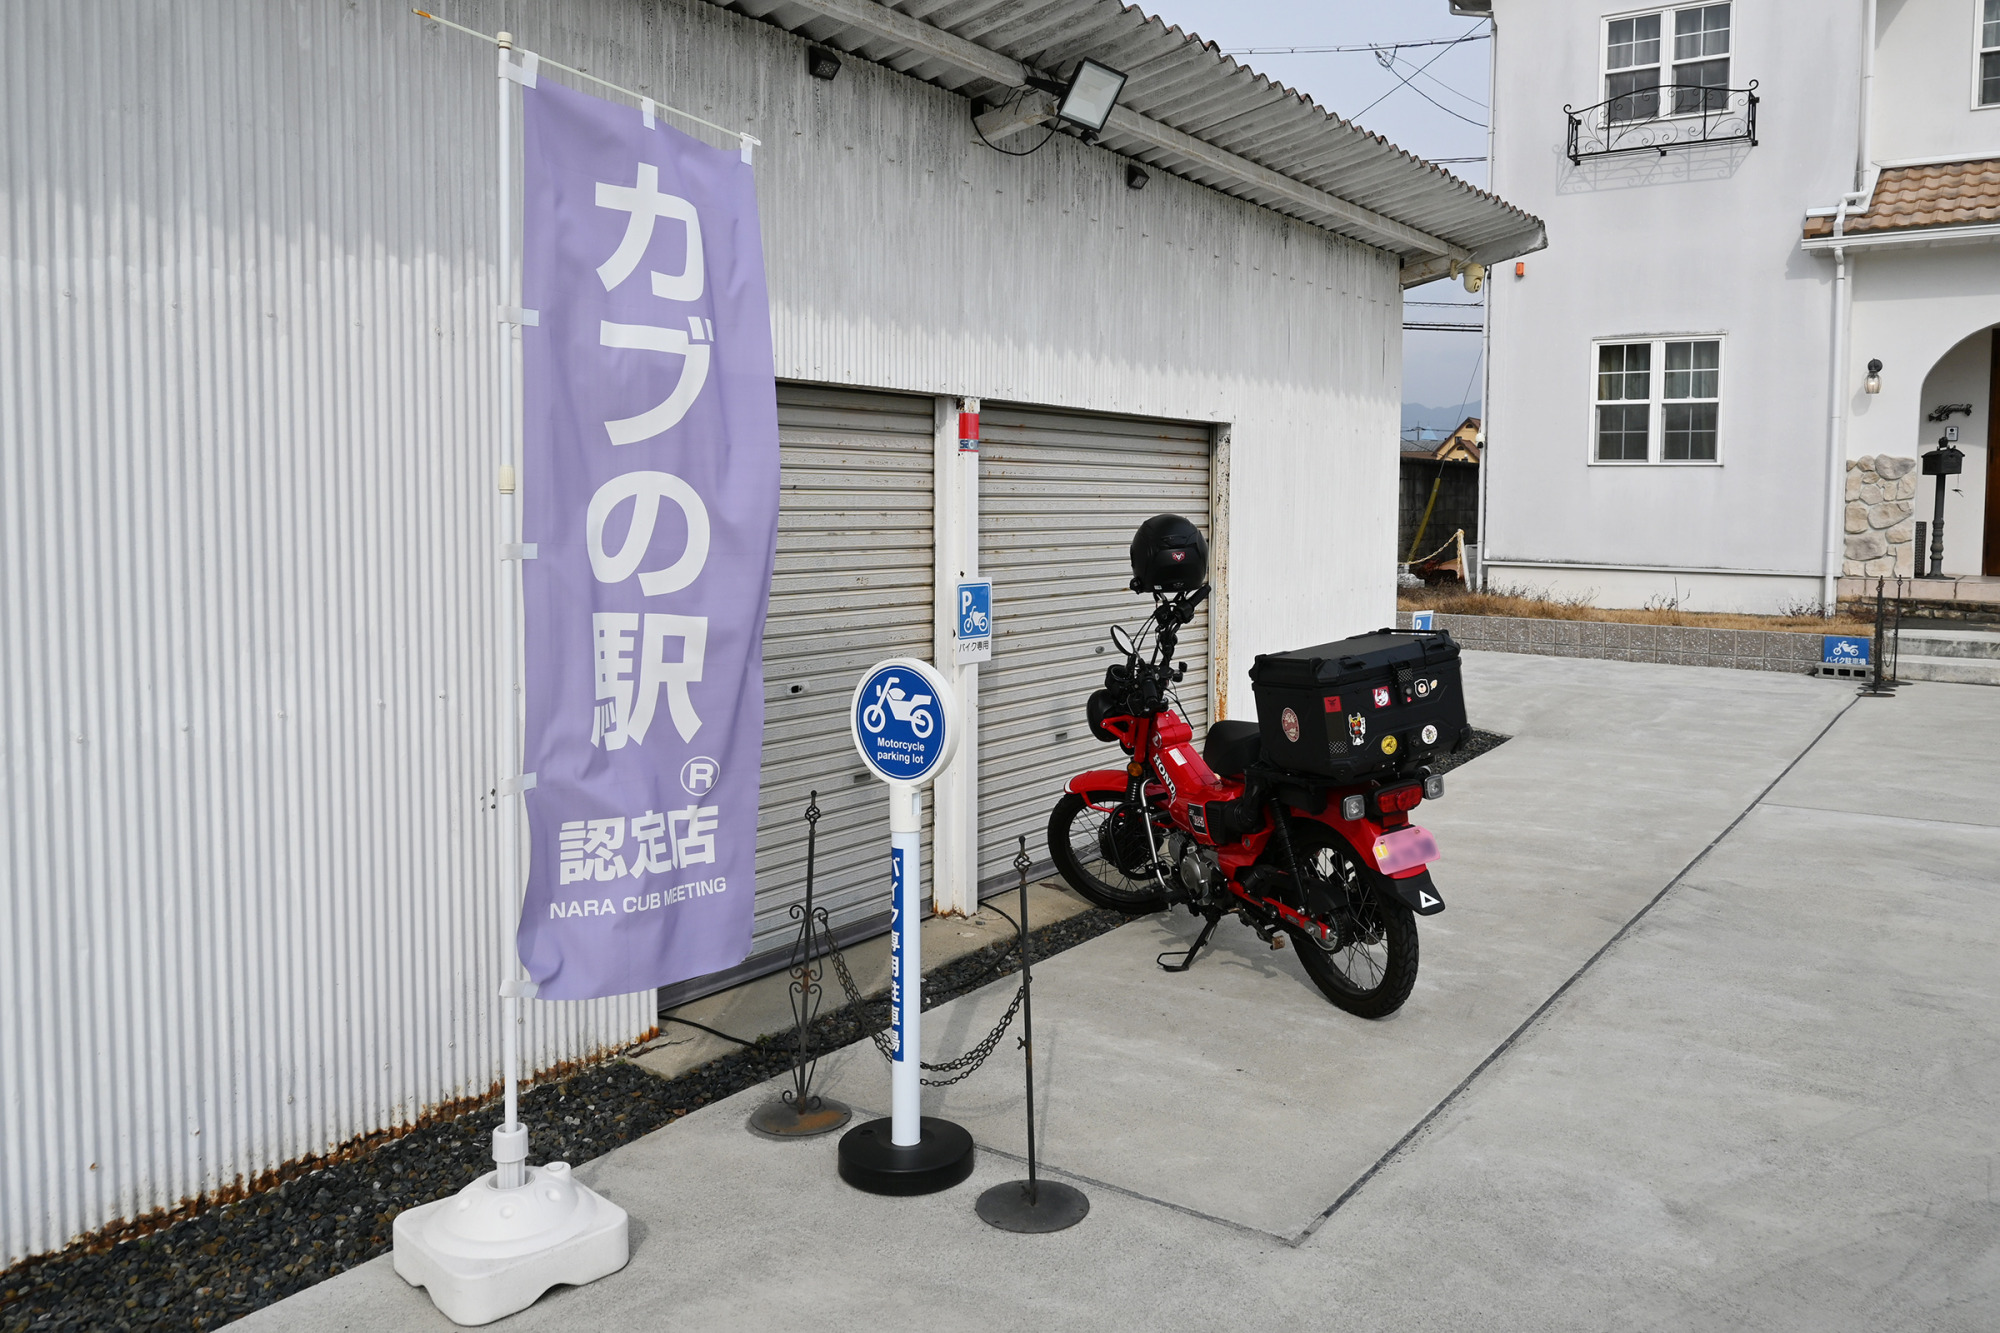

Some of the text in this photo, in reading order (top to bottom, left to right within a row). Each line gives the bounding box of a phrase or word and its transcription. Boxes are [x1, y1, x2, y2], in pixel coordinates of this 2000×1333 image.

[586, 162, 714, 750] カブの駅
[961, 590, 973, 615] P
[959, 640, 989, 652] バイク専用
[877, 737, 925, 752] Motorcycle
[877, 751, 924, 765] parking lot
[558, 805, 719, 886] 認定店
[550, 876, 727, 919] NARA CUB MEETING
